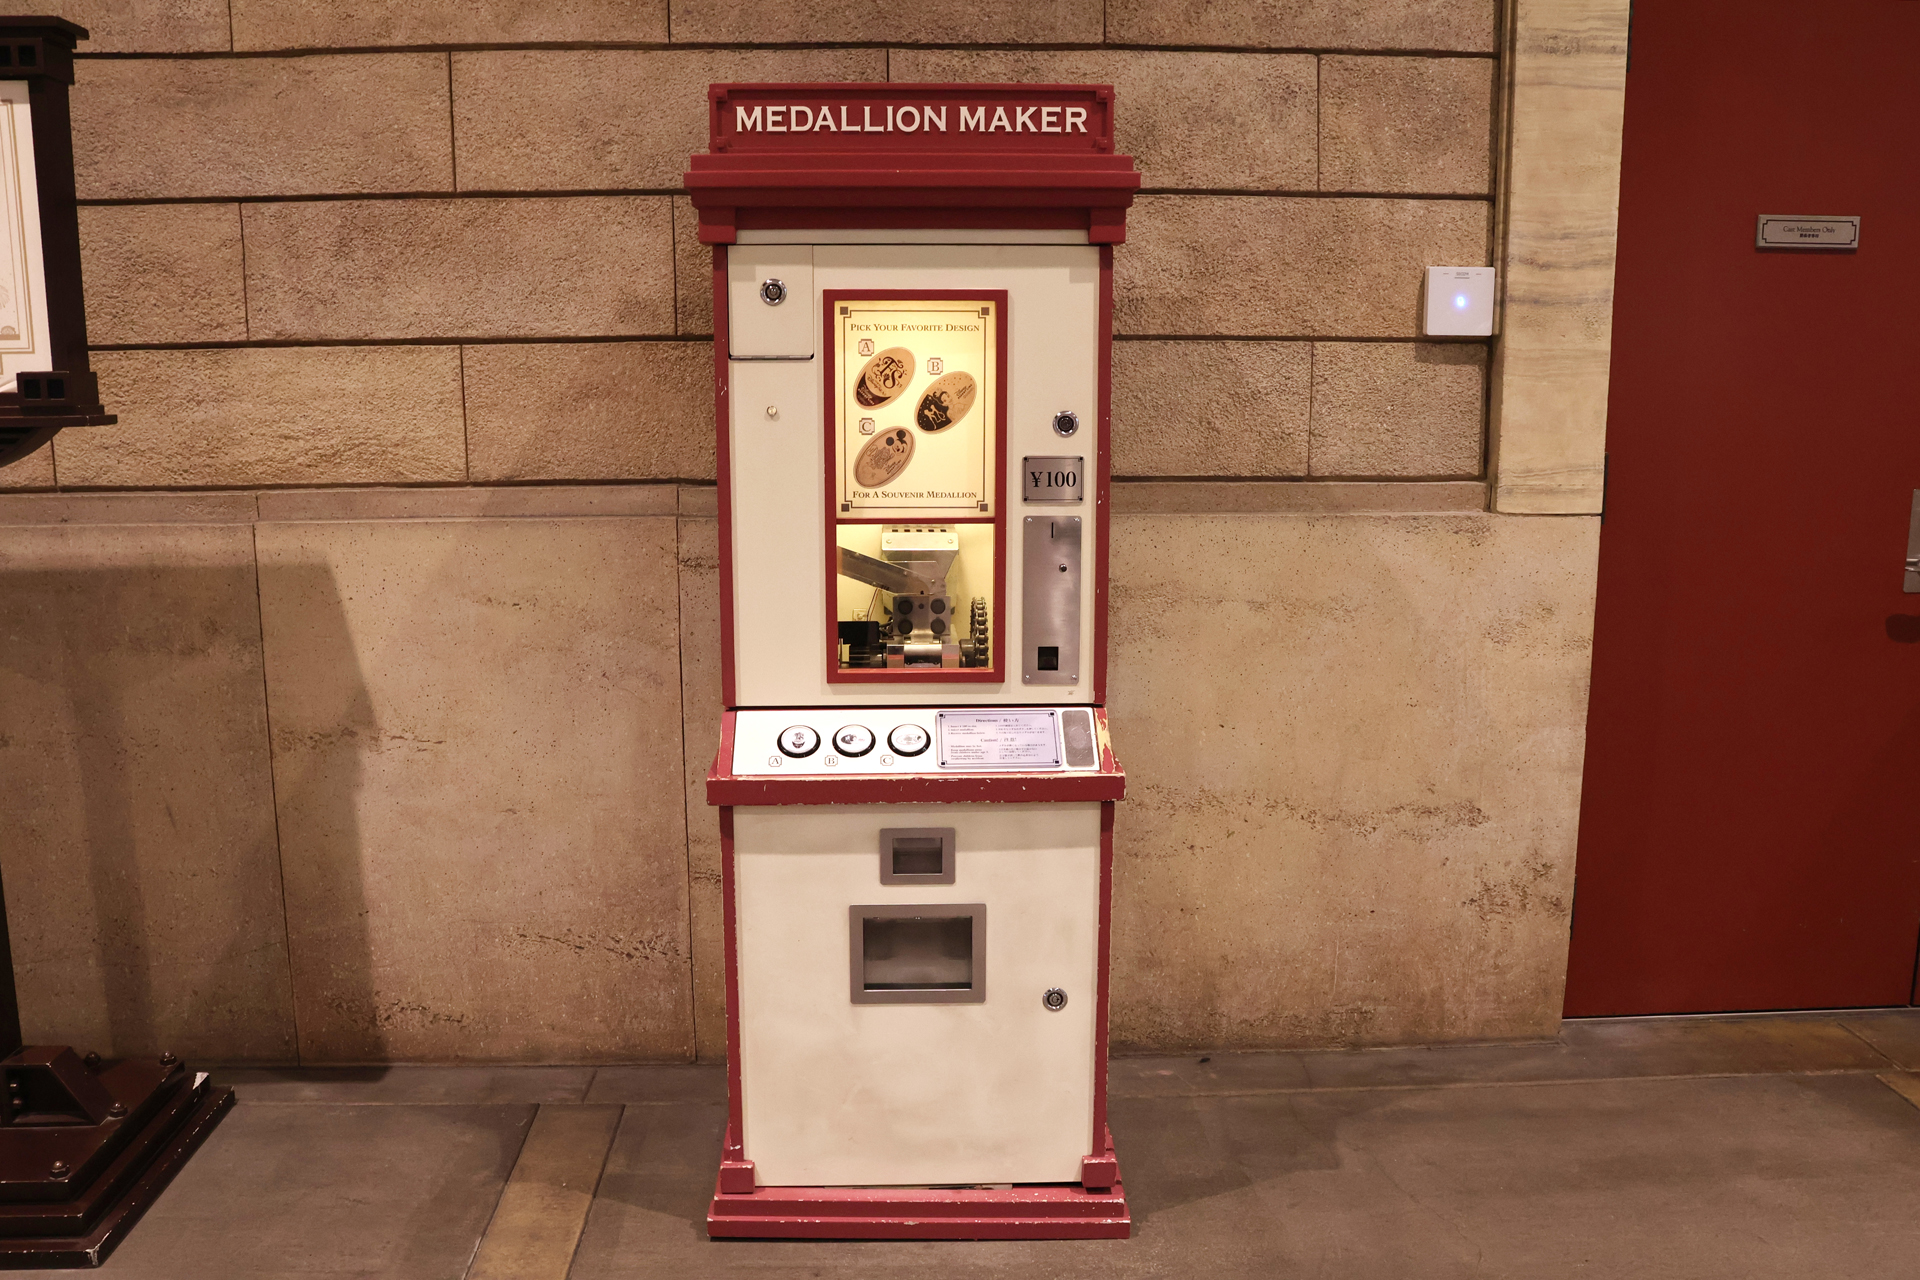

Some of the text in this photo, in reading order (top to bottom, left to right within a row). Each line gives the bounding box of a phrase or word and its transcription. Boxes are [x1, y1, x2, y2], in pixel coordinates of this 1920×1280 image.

[735, 105, 1089, 133] MEDALLION MAKER
[850, 323, 980, 332] PICK YOUR FAVORITE DESIGN
[861, 341, 871, 352] A
[931, 361, 940, 372] B
[861, 421, 872, 433] C
[1030, 471, 1077, 488] ¥100
[852, 490, 977, 499] FOR A SOUVENIR MEDALLION
[771, 757, 780, 765] A
[828, 757, 835, 765] B
[882, 756, 891, 764] C
